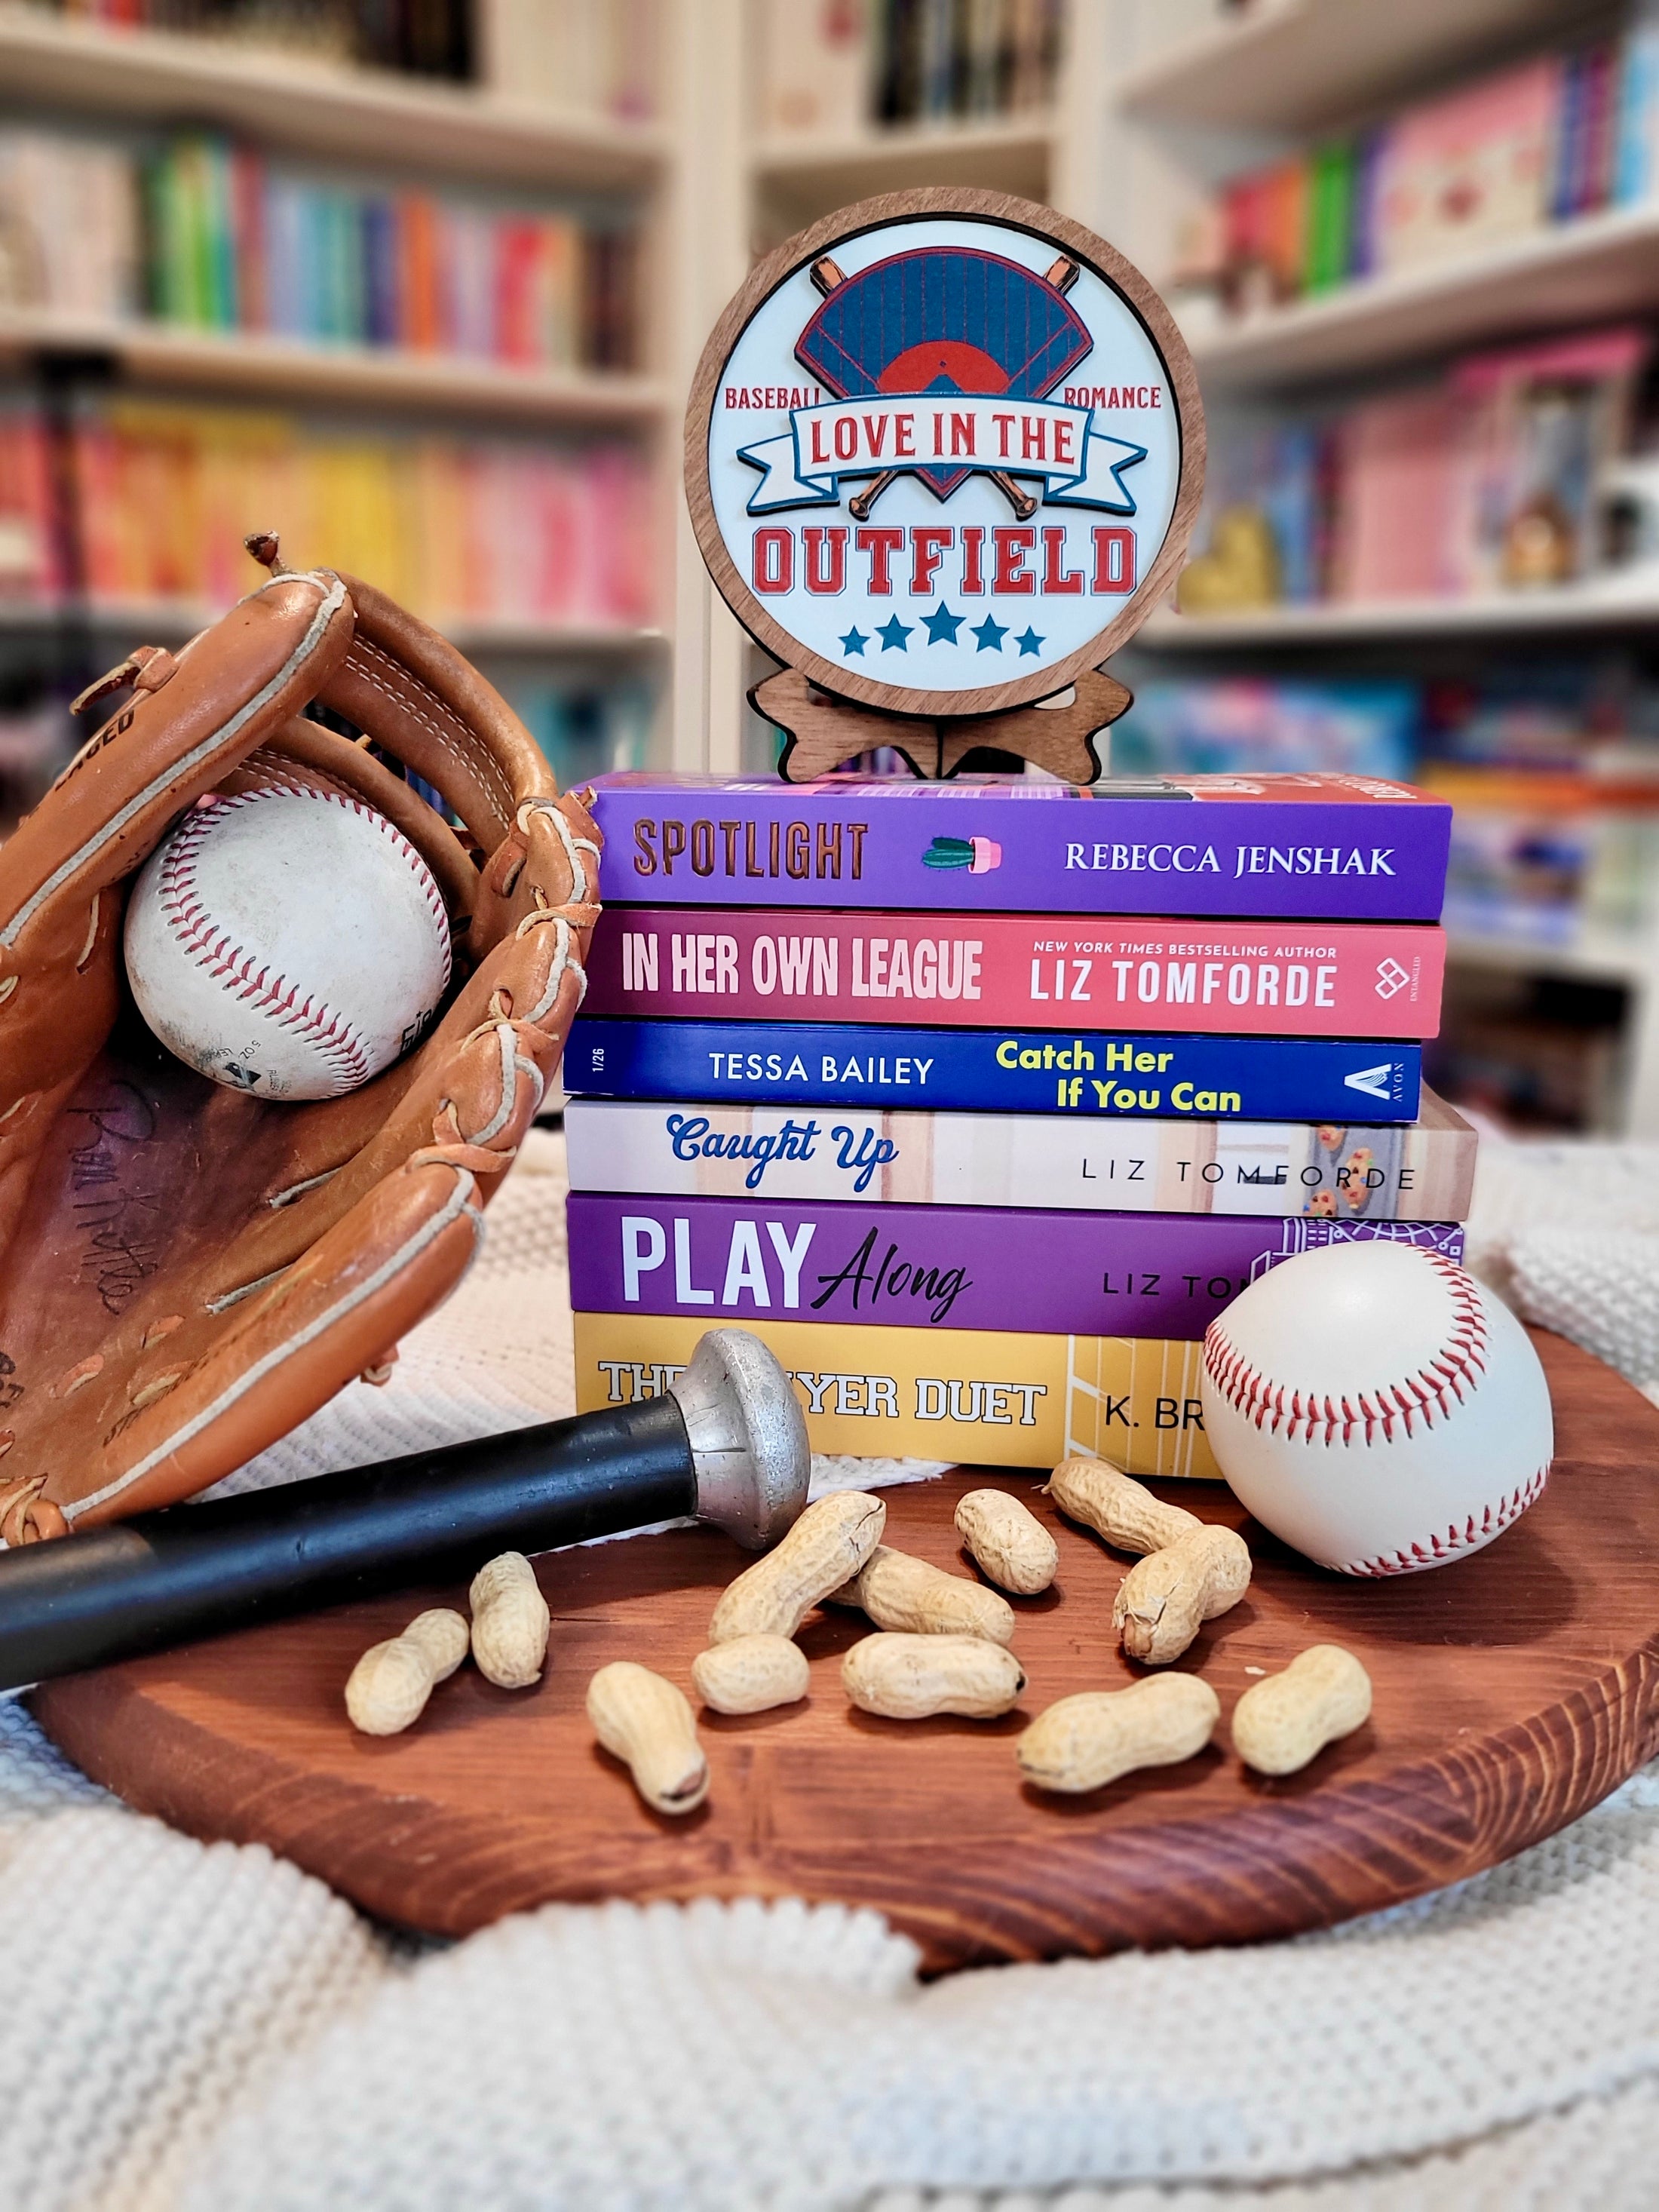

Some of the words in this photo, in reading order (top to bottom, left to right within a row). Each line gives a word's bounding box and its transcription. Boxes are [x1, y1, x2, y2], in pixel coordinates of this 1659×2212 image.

[1064, 387, 1161, 408] ROMANCE
[811, 413, 916, 465] LOVE
[933, 413, 977, 456] IN
[992, 414, 1075, 465] THE
[753, 526, 1137, 596] OUTFIELD
[633, 818, 869, 879] SPOTLIGHT
[1065, 843, 1221, 873] REBECCA
[1233, 846, 1397, 879] JENSHAK
[622, 933, 658, 991] IN
[671, 934, 739, 994] HER
[752, 936, 839, 996] OWN
[851, 938, 983, 1000] LEAGUE
[1033, 941, 1069, 953] NEW
[1074, 942, 1113, 954] YORK
[1119, 943, 1163, 955] TIMES
[1168, 943, 1269, 957] BESTSELLING
[1274, 946, 1337, 959] AUTHOR
[1030, 959, 1093, 1001] LIZ
[1112, 961, 1338, 1008] TOMFORDE
[592, 1048, 604, 1072] 1/26
[708, 1053, 808, 1081] TESSA
[821, 1056, 934, 1085] BAILEY
[996, 1042, 1095, 1070] Catch
[1106, 1044, 1173, 1073] Her
[1057, 1078, 1084, 1109] If
[1090, 1081, 1160, 1111] You
[1170, 1082, 1241, 1112] Can
[1393, 1063, 1404, 1103] AVON
[666, 1114, 821, 1189] Caught
[830, 1125, 900, 1192] Up
[1082, 1158, 1145, 1180] LIZ
[1176, 1161, 1415, 1190] TOMFORDE
[621, 1216, 817, 1308] PLAY
[810, 1226, 973, 1324] Along
[1103, 1272, 1161, 1296] LIZ
[915, 1378, 1047, 1426] DUET
[1105, 1395, 1139, 1428] K.
